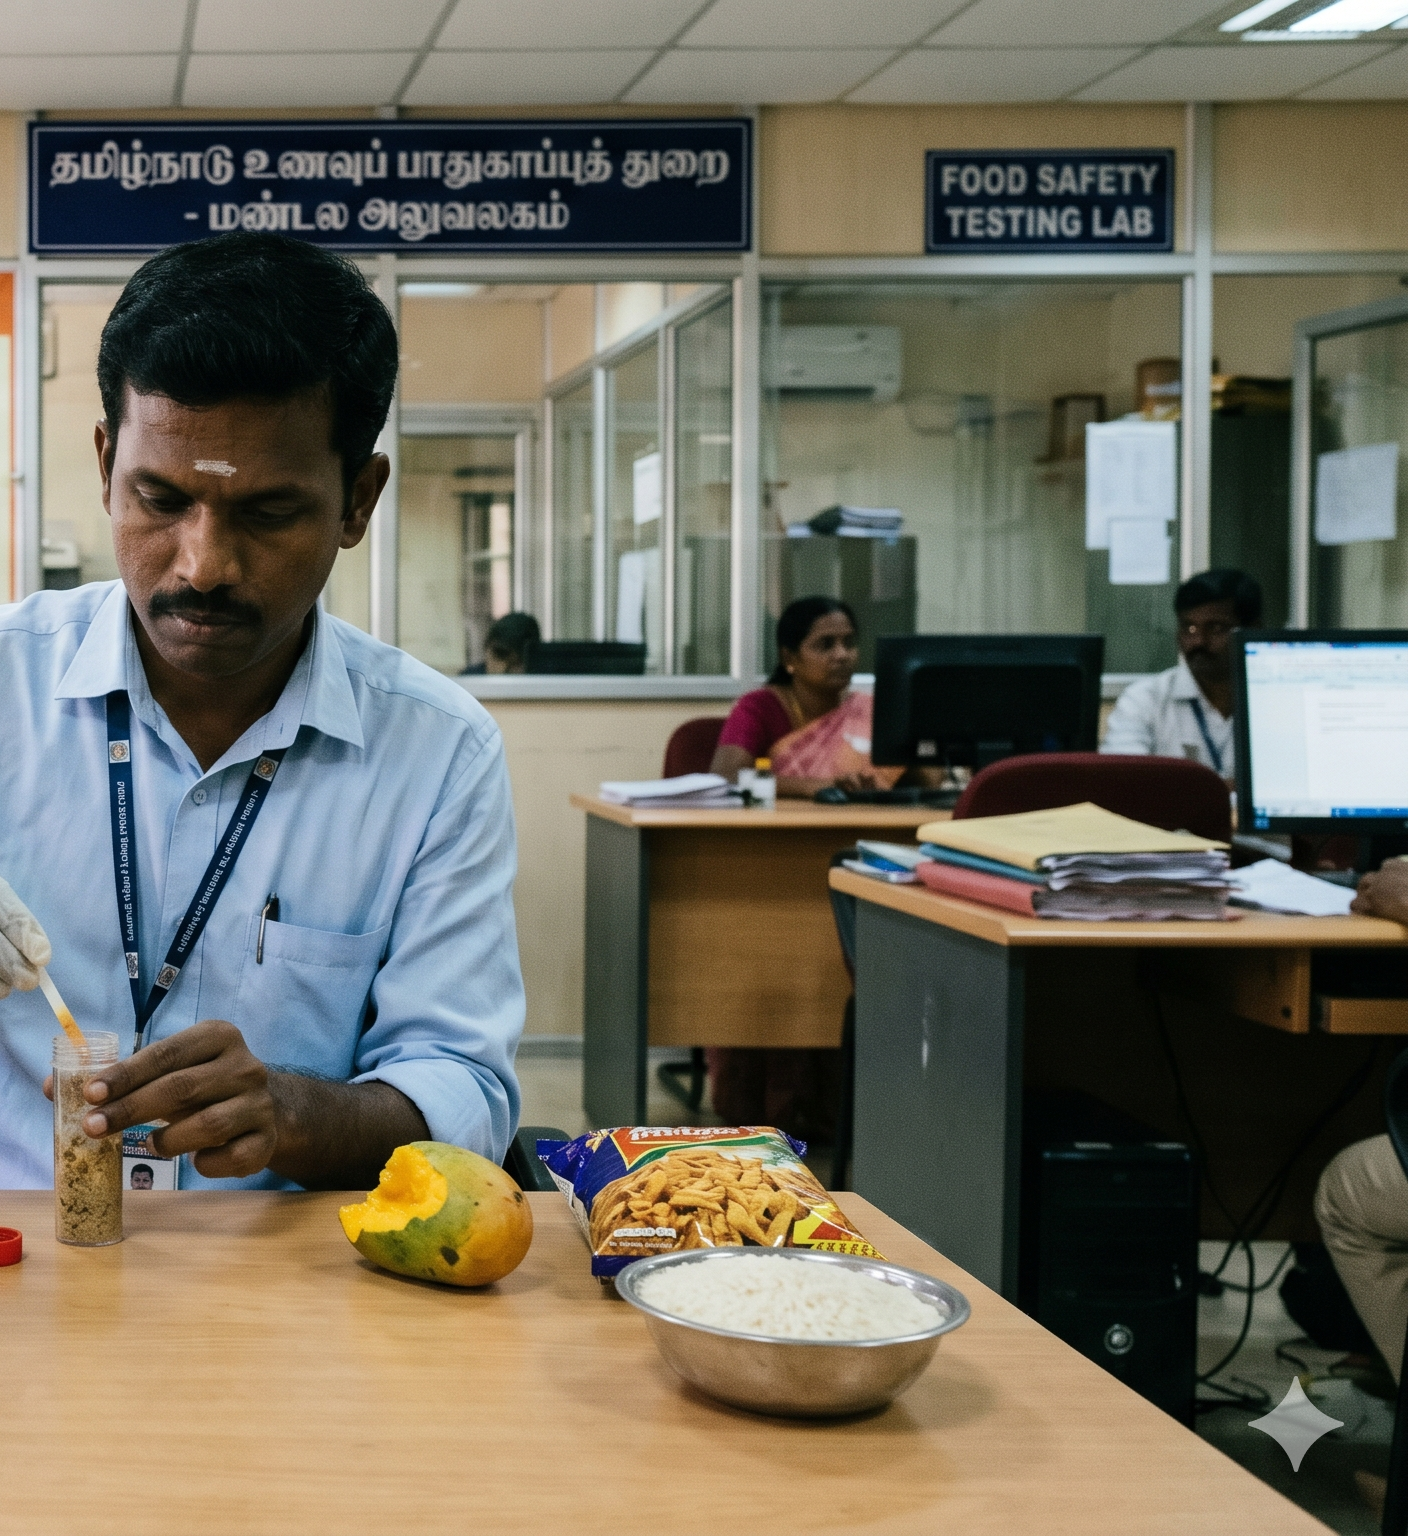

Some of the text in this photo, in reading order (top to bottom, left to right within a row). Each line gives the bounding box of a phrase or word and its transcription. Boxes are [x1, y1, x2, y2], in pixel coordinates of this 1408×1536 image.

[49, 136, 730, 191] தமிழ்நாடு உணவுப் பாதுகாப்புத் துறை
[942, 163, 1159, 196] FOOD SAFETY
[208, 189, 349, 231] மண்டல
[358, 189, 570, 241] அலுவலகம்
[946, 205, 1154, 238] TESTING LAB
